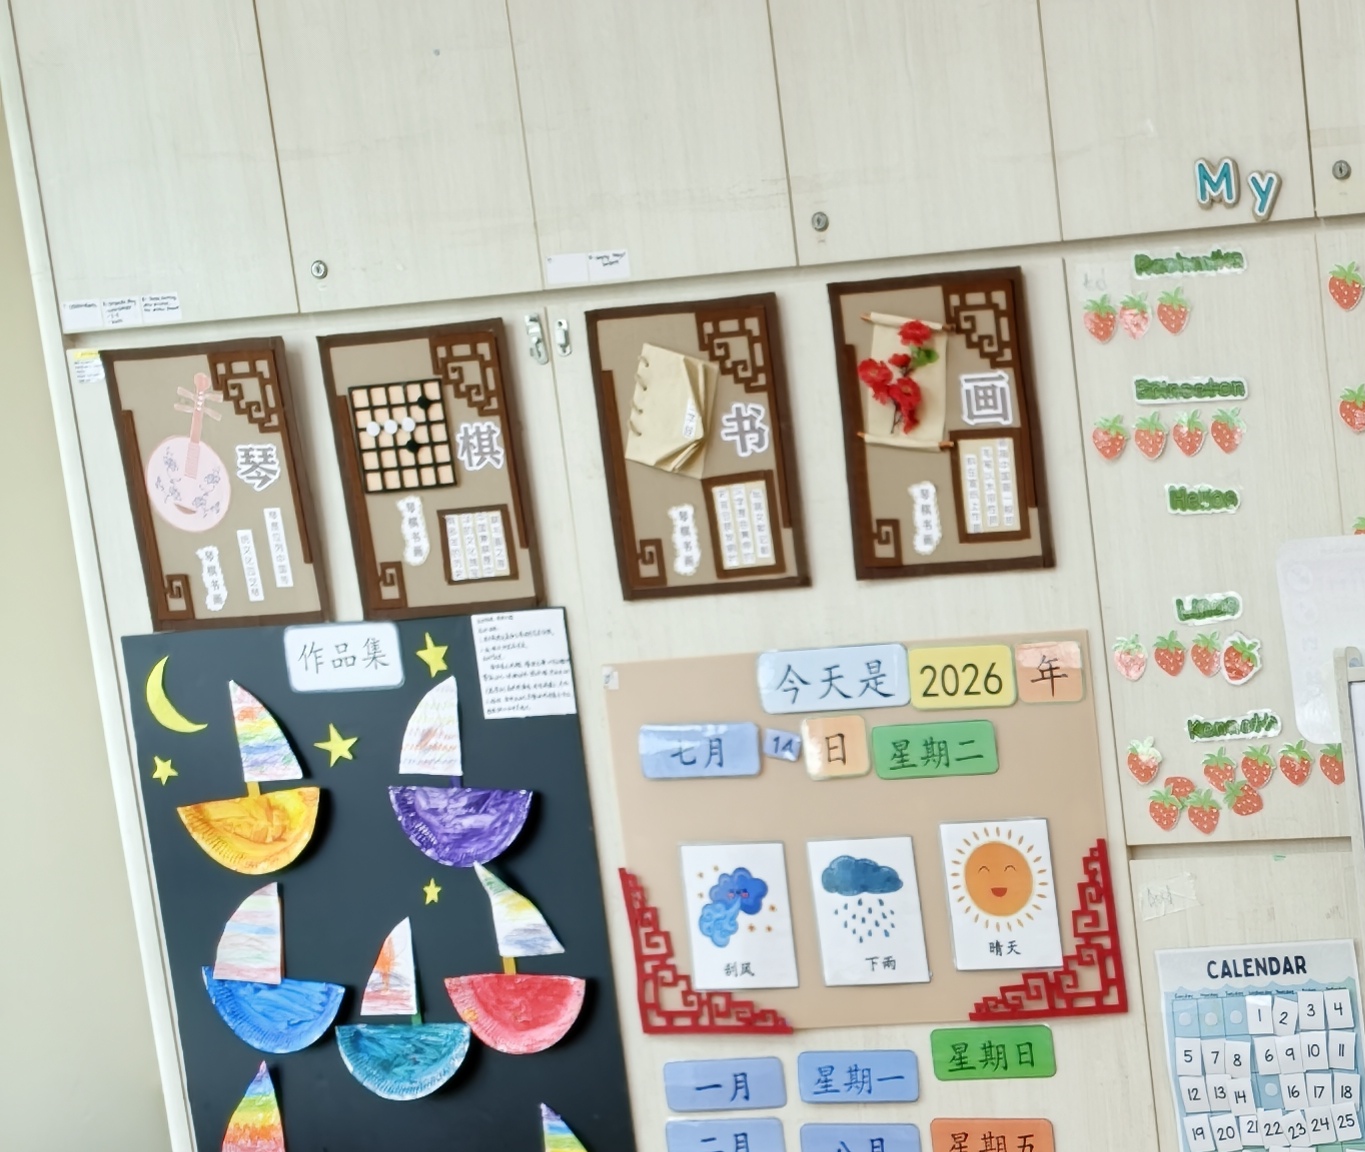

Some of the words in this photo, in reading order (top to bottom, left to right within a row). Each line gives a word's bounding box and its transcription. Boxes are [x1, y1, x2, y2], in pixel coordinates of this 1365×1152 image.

[1199, 158, 1276, 215] My
[961, 374, 1010, 424] 画
[458, 425, 503, 469] 棋
[723, 406, 768, 455] 书
[238, 446, 280, 488] 琴
[298, 637, 391, 673] 作品集
[776, 658, 897, 705] 今天是
[920, 661, 1004, 699] 2026
[1030, 654, 1069, 699] 年
[670, 737, 725, 769] 七月
[825, 732, 847, 765] 日
[889, 735, 985, 771] 星期二
[864, 955, 897, 971] 下雨
[988, 939, 1022, 957] 晴天
[1206, 955, 1307, 980] CALENDAR
[1257, 1008, 1262, 1022] 1
[1278, 1011, 1288, 1025] 2
[1306, 1002, 1316, 1017] 3
[1333, 1001, 1343, 1016] 4
[947, 1040, 1035, 1073] 星期日
[1183, 1049, 1193, 1063] 5
[1210, 1050, 1220, 1065] 7
[1233, 1053, 1242, 1067] 8
[1264, 1048, 1274, 1062] 6
[1285, 1047, 1296, 1062] 9
[1307, 1043, 1320, 1058] 10
[1338, 1043, 1345, 1057] 11
[695, 1071, 750, 1103] 一月
[813, 1063, 905, 1097] 星期一
[1187, 1087, 1201, 1101] 12
[1213, 1085, 1226, 1099] 13
[1233, 1090, 1247, 1104] 14
[1287, 1085, 1300, 1099] 16
[1313, 1084, 1325, 1099] 17
[1340, 1084, 1352, 1099] 18
[1191, 1126, 1205, 1141] 19
[1216, 1126, 1236, 1141] 20
[1247, 1120, 1259, 1134] 21
[1263, 1121, 1284, 1136] 22
[1287, 1124, 1307, 1140] 23
[1311, 1116, 1330, 1132] 24
[1336, 1114, 1355, 1129] 25
